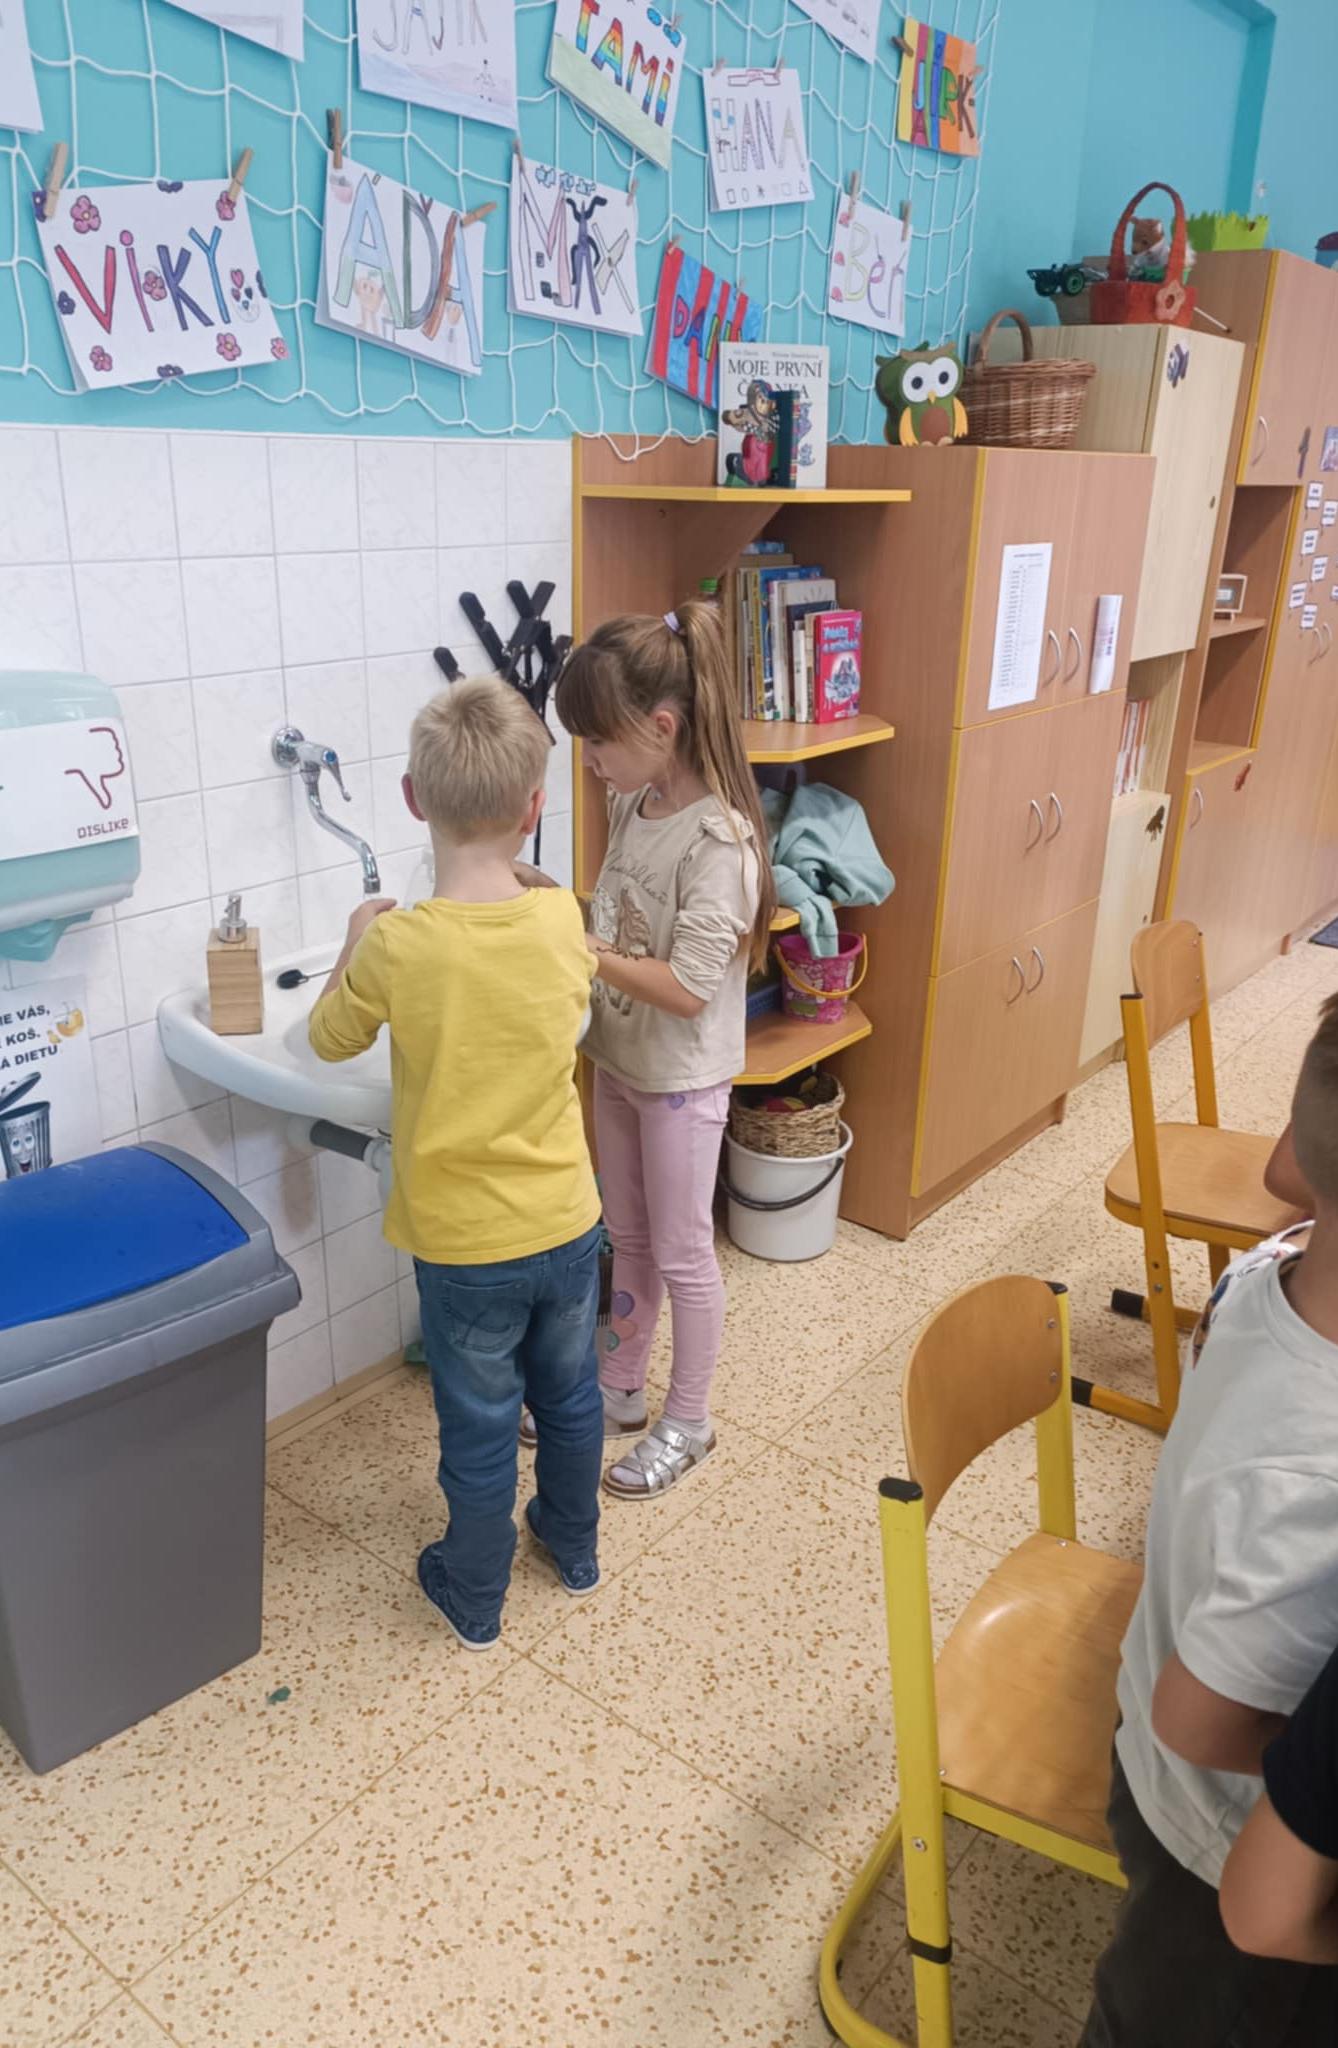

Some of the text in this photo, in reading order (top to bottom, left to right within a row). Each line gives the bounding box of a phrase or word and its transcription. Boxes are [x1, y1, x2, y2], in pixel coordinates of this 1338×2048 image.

[711, 97, 806, 173] HANA
[332, 172, 483, 367] ADA
[727, 358, 823, 379] MOJE PRVNÍ
[16, 1004, 51, 1021] VÁS,
[5, 1027, 41, 1047] KOŠ.
[14, 1043, 58, 1066] DIETU
